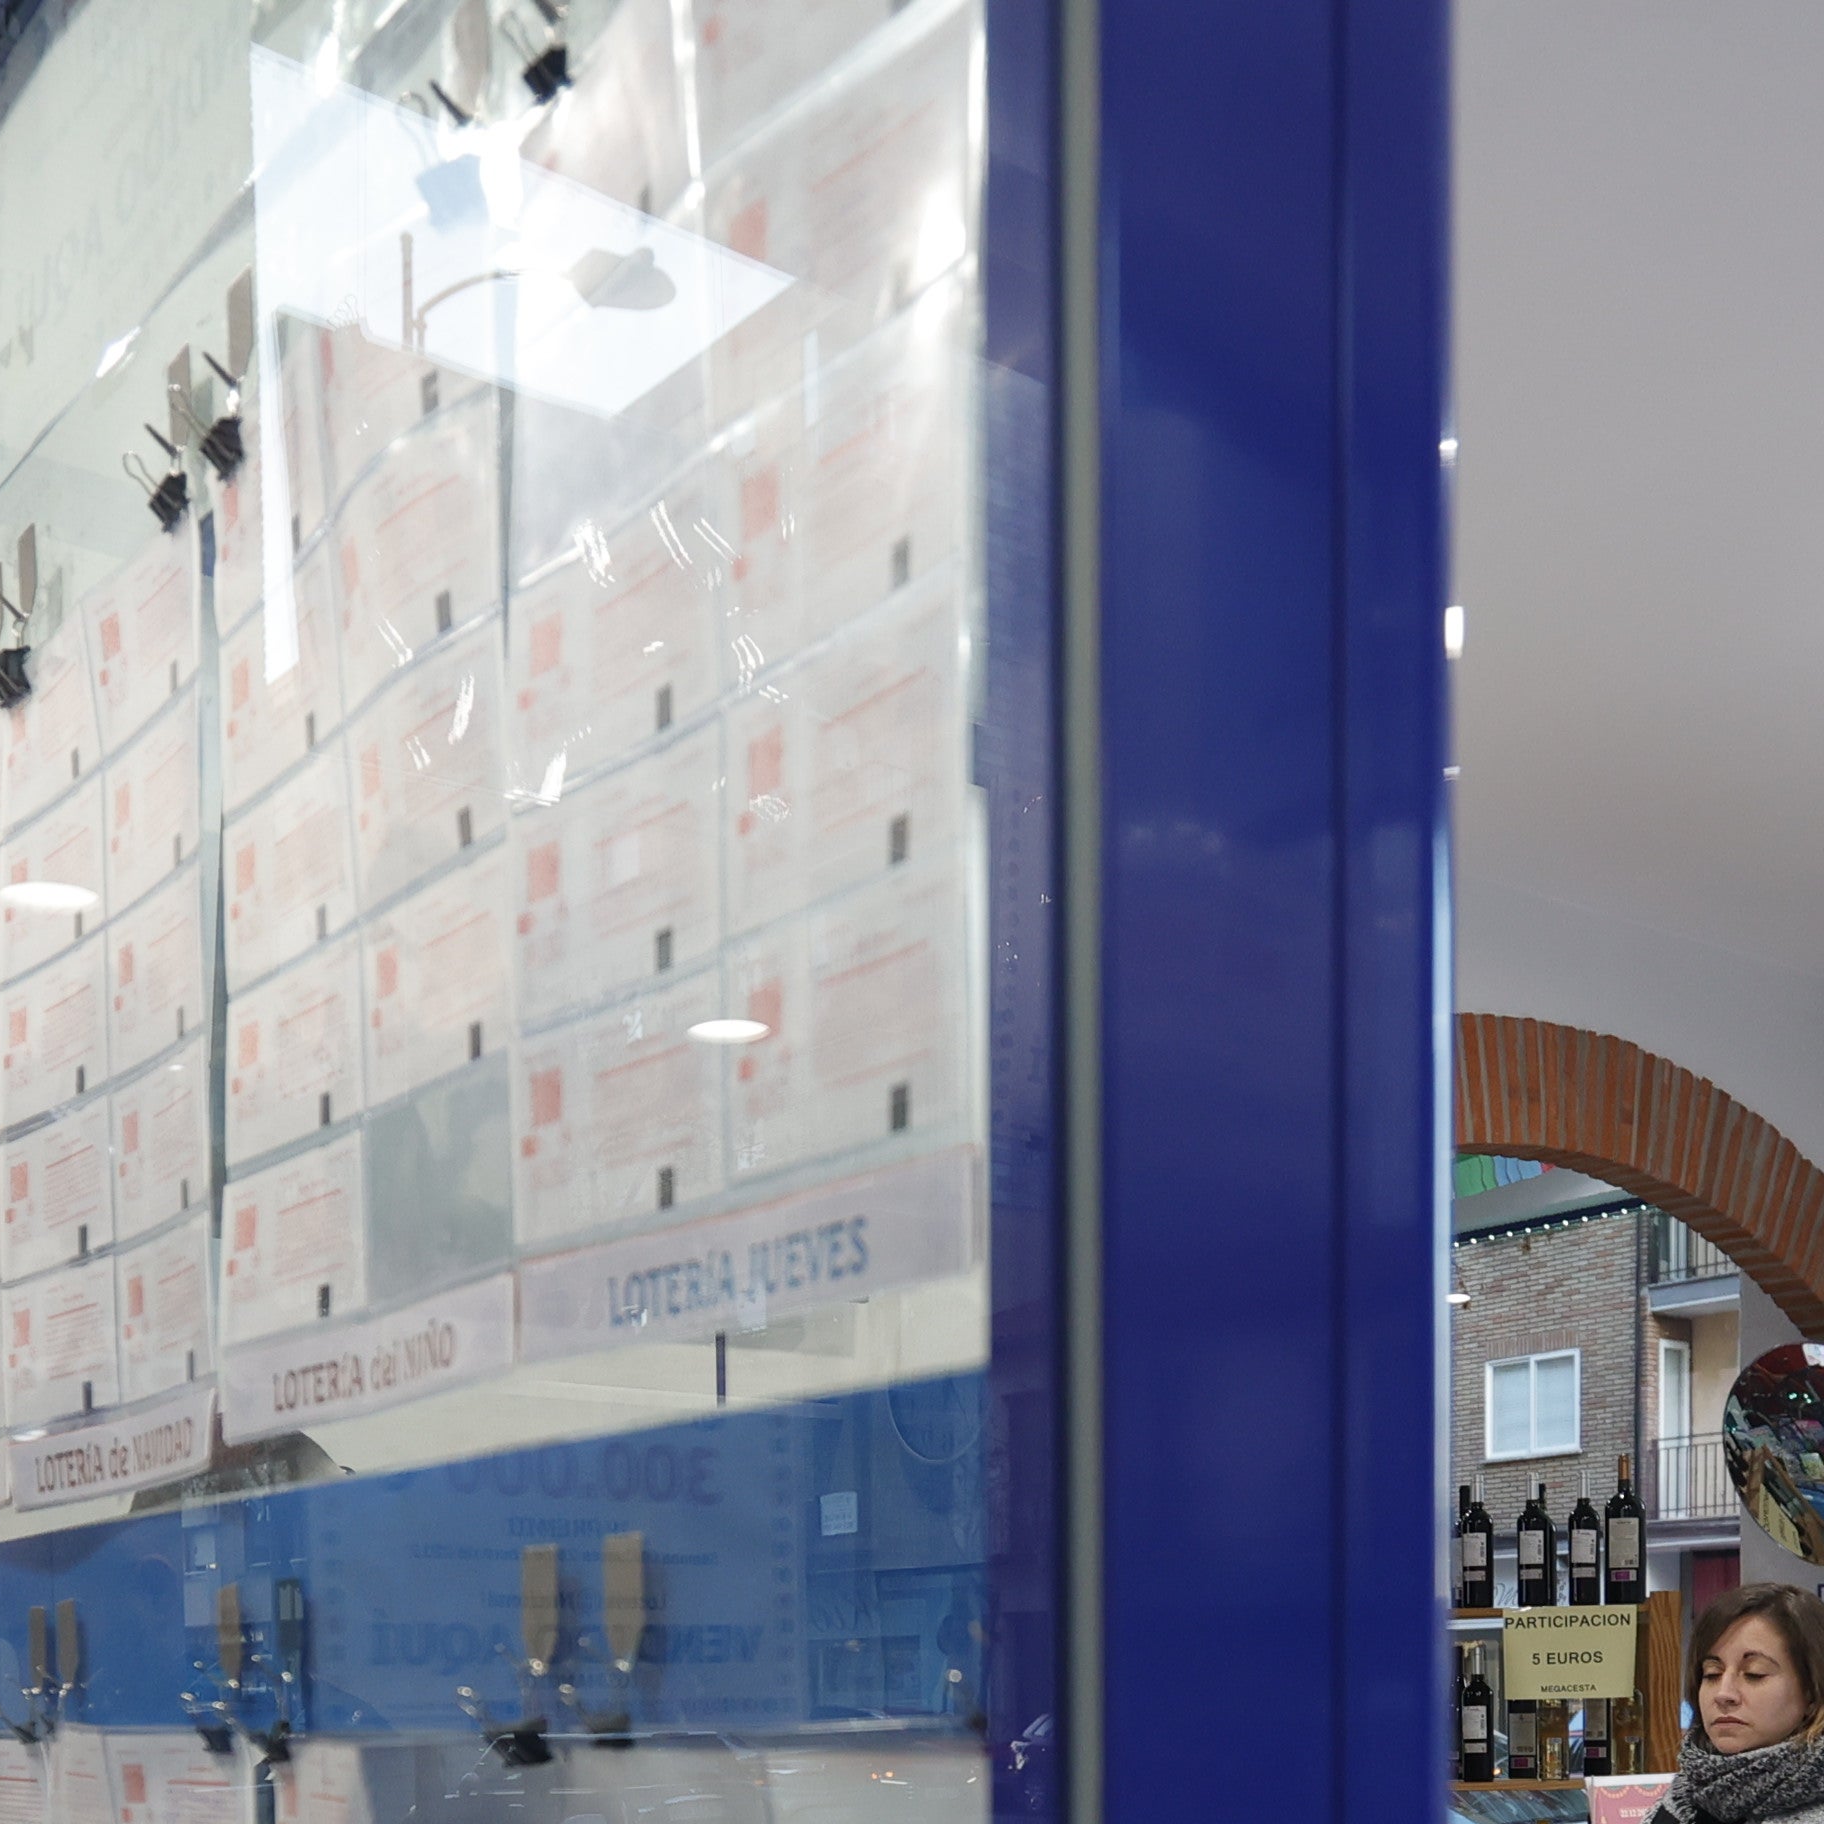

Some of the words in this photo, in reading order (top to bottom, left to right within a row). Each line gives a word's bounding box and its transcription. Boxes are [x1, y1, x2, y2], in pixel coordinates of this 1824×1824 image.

[273, 1352, 363, 1412] LOTERÍA
[404, 1317, 457, 1380] NIÑO
[34, 1442, 105, 1494] LOTERÍA
[108, 1437, 129, 1480] de
[1504, 1613, 1631, 1629] PARTICIPACION
[1532, 1653, 1541, 1665] 5
[1547, 1651, 1604, 1665] EUROS
[1540, 1684, 1597, 1693] MEGACESTA
